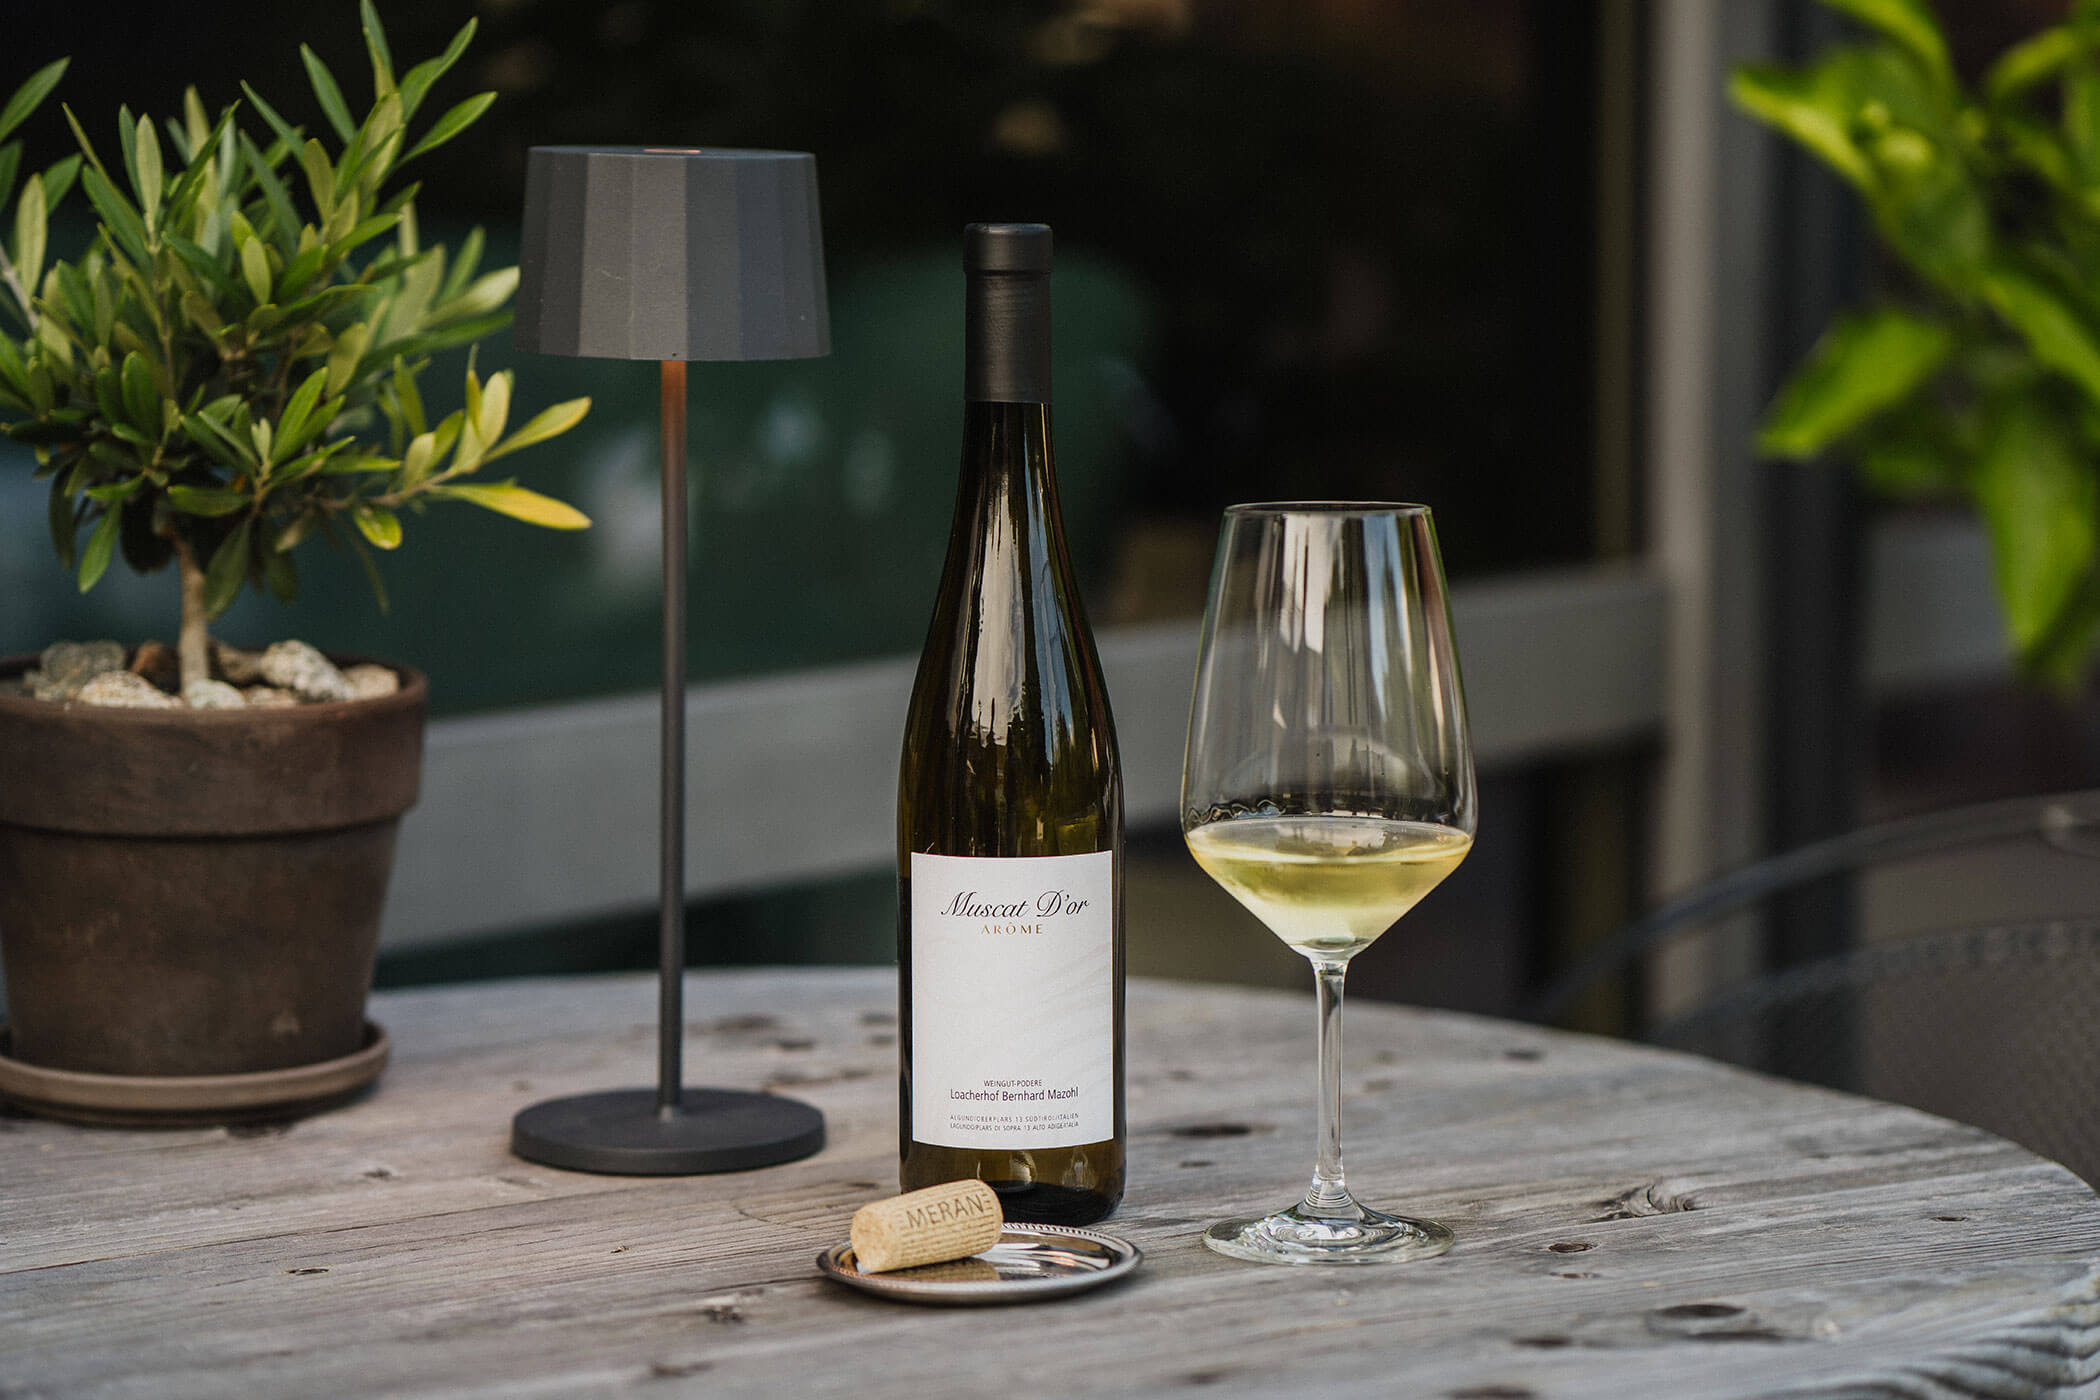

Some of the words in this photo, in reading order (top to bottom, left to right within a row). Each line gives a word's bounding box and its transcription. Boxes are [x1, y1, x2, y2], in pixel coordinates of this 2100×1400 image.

[940, 891, 1031, 918] Muscat
[1035, 889, 1090, 918] D'or
[981, 921, 1043, 934] ARÔME
[983, 1079, 1042, 1088] WEINGUT-PODERE
[950, 1088, 1000, 1101] Loacherhof
[1002, 1089, 1045, 1101] Bernhard
[1047, 1086, 1079, 1100] Mazohl
[1032, 1123, 1046, 1131] ALTO
[906, 1193, 985, 1229] MERAN
